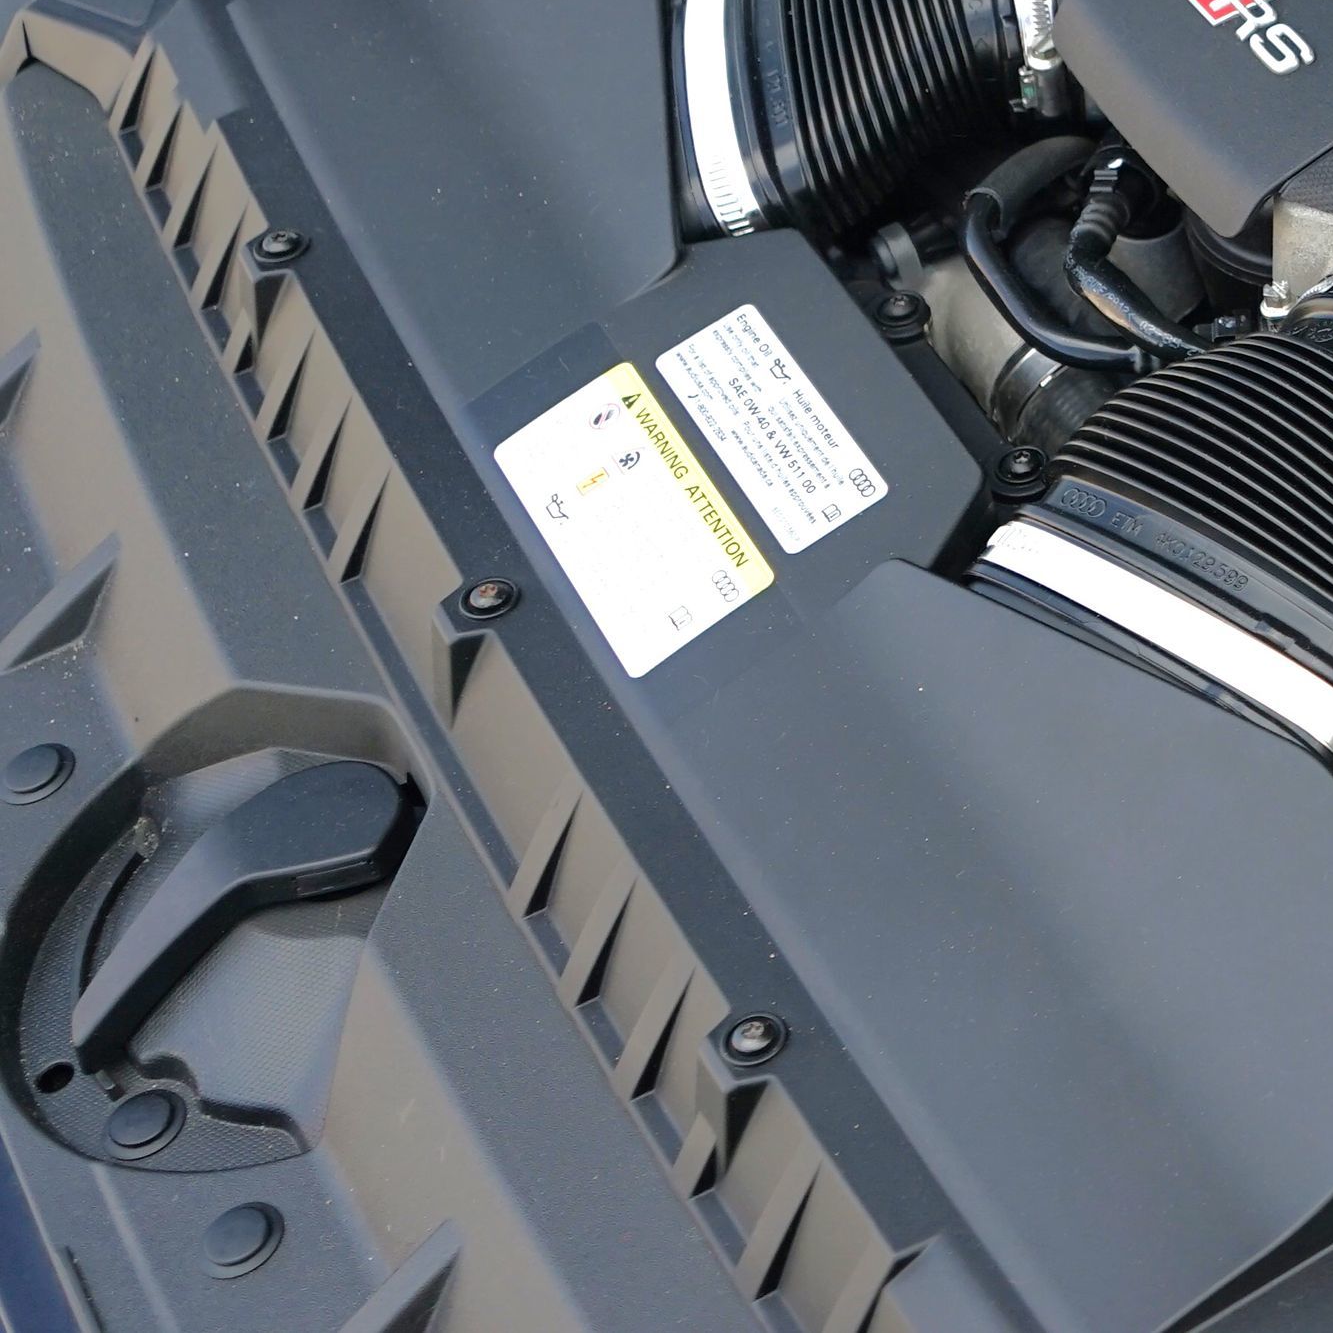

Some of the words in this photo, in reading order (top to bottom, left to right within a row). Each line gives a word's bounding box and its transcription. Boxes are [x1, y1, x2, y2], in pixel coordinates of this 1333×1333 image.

[734, 313, 763, 345] Engine
[757, 342, 773, 358] Oil
[727, 376, 748, 399] SAE
[742, 397, 770, 430] 0W-40
[765, 429, 777, 440] &
[772, 439, 792, 460] VW
[786, 458, 805, 479] 511
[800, 478, 817, 495] 00
[741, 421, 755, 435] Pour
[791, 388, 814, 414] Huile
[809, 413, 840, 450] moteur
[793, 420, 824, 458] uniquement
[820, 455, 830, 466] de
[633, 406, 689, 480] WARNING
[684, 480, 749, 569] ATTENTION
[1111, 512, 1144, 537] ETM
